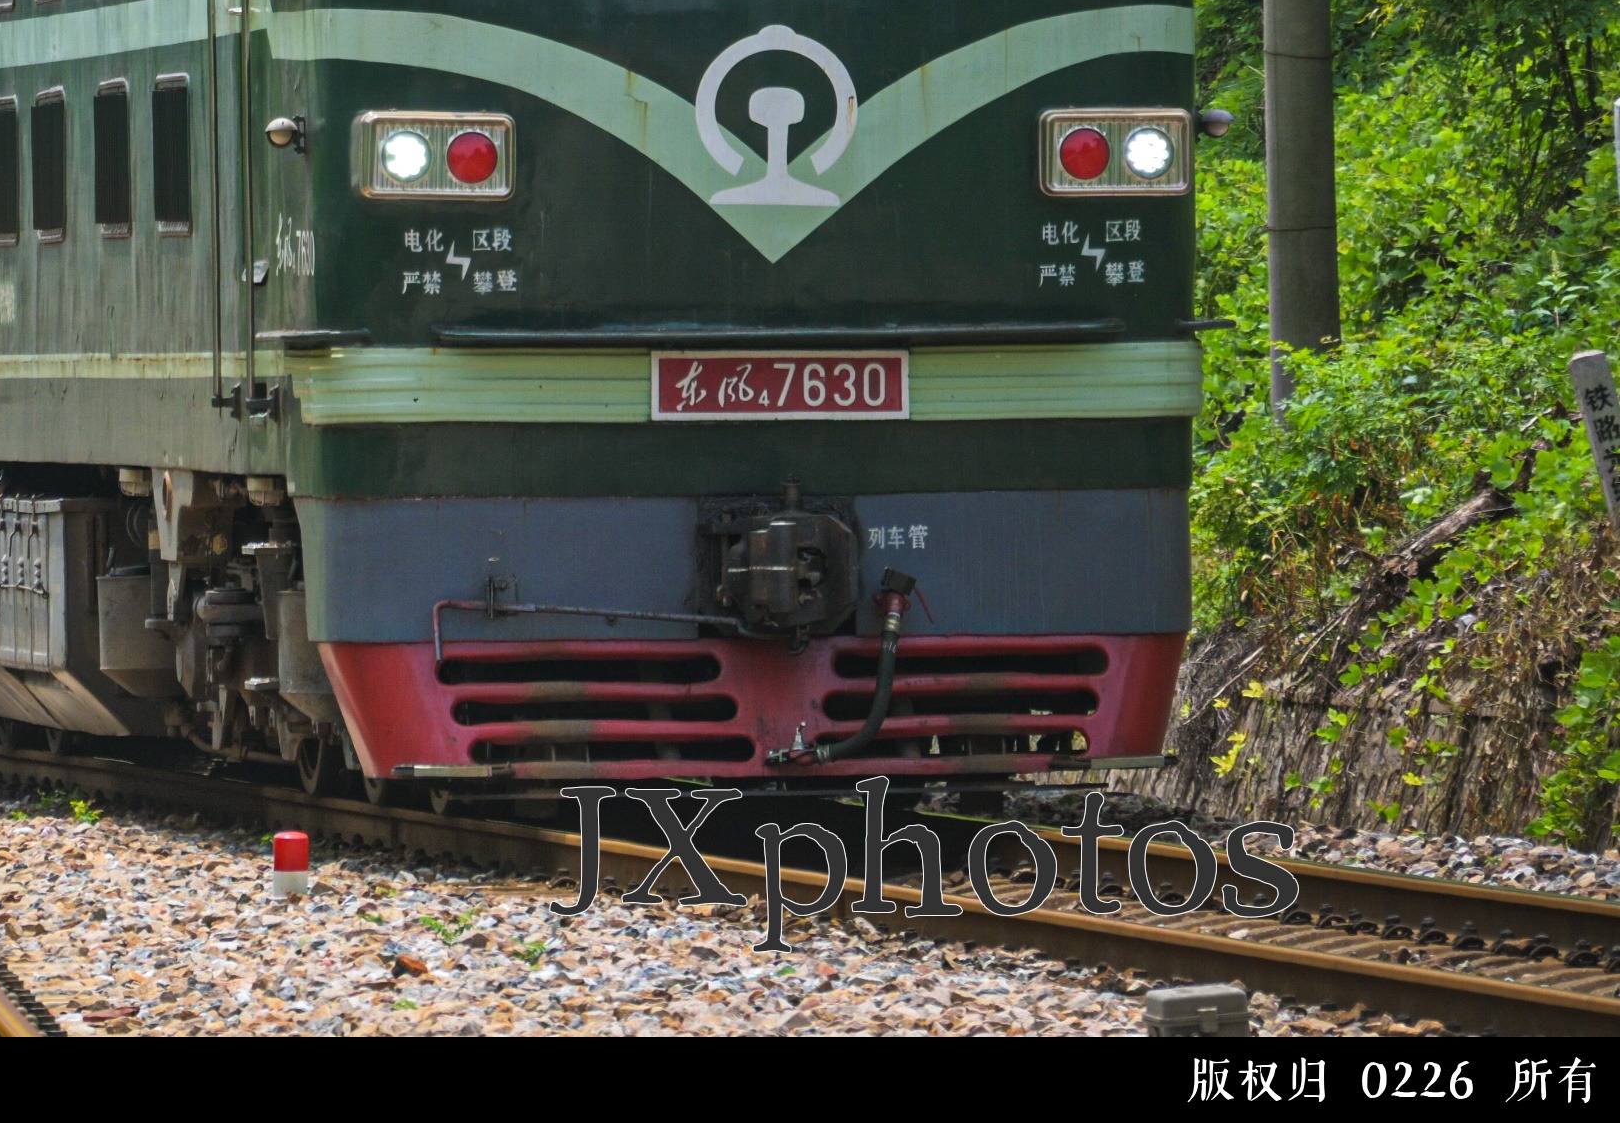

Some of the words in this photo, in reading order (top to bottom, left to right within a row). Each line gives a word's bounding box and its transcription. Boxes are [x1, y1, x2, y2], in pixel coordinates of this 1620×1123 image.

[404, 229, 444, 253] 电化
[473, 228, 512, 252] 区段
[1042, 221, 1080, 246] 电化
[1105, 219, 1141, 243] 区段
[402, 271, 442, 295] 严禁
[473, 269, 516, 295] 攀登
[1039, 263, 1076, 288] 严禁
[1105, 260, 1145, 286] 攀登
[867, 525, 929, 550] 列车管
